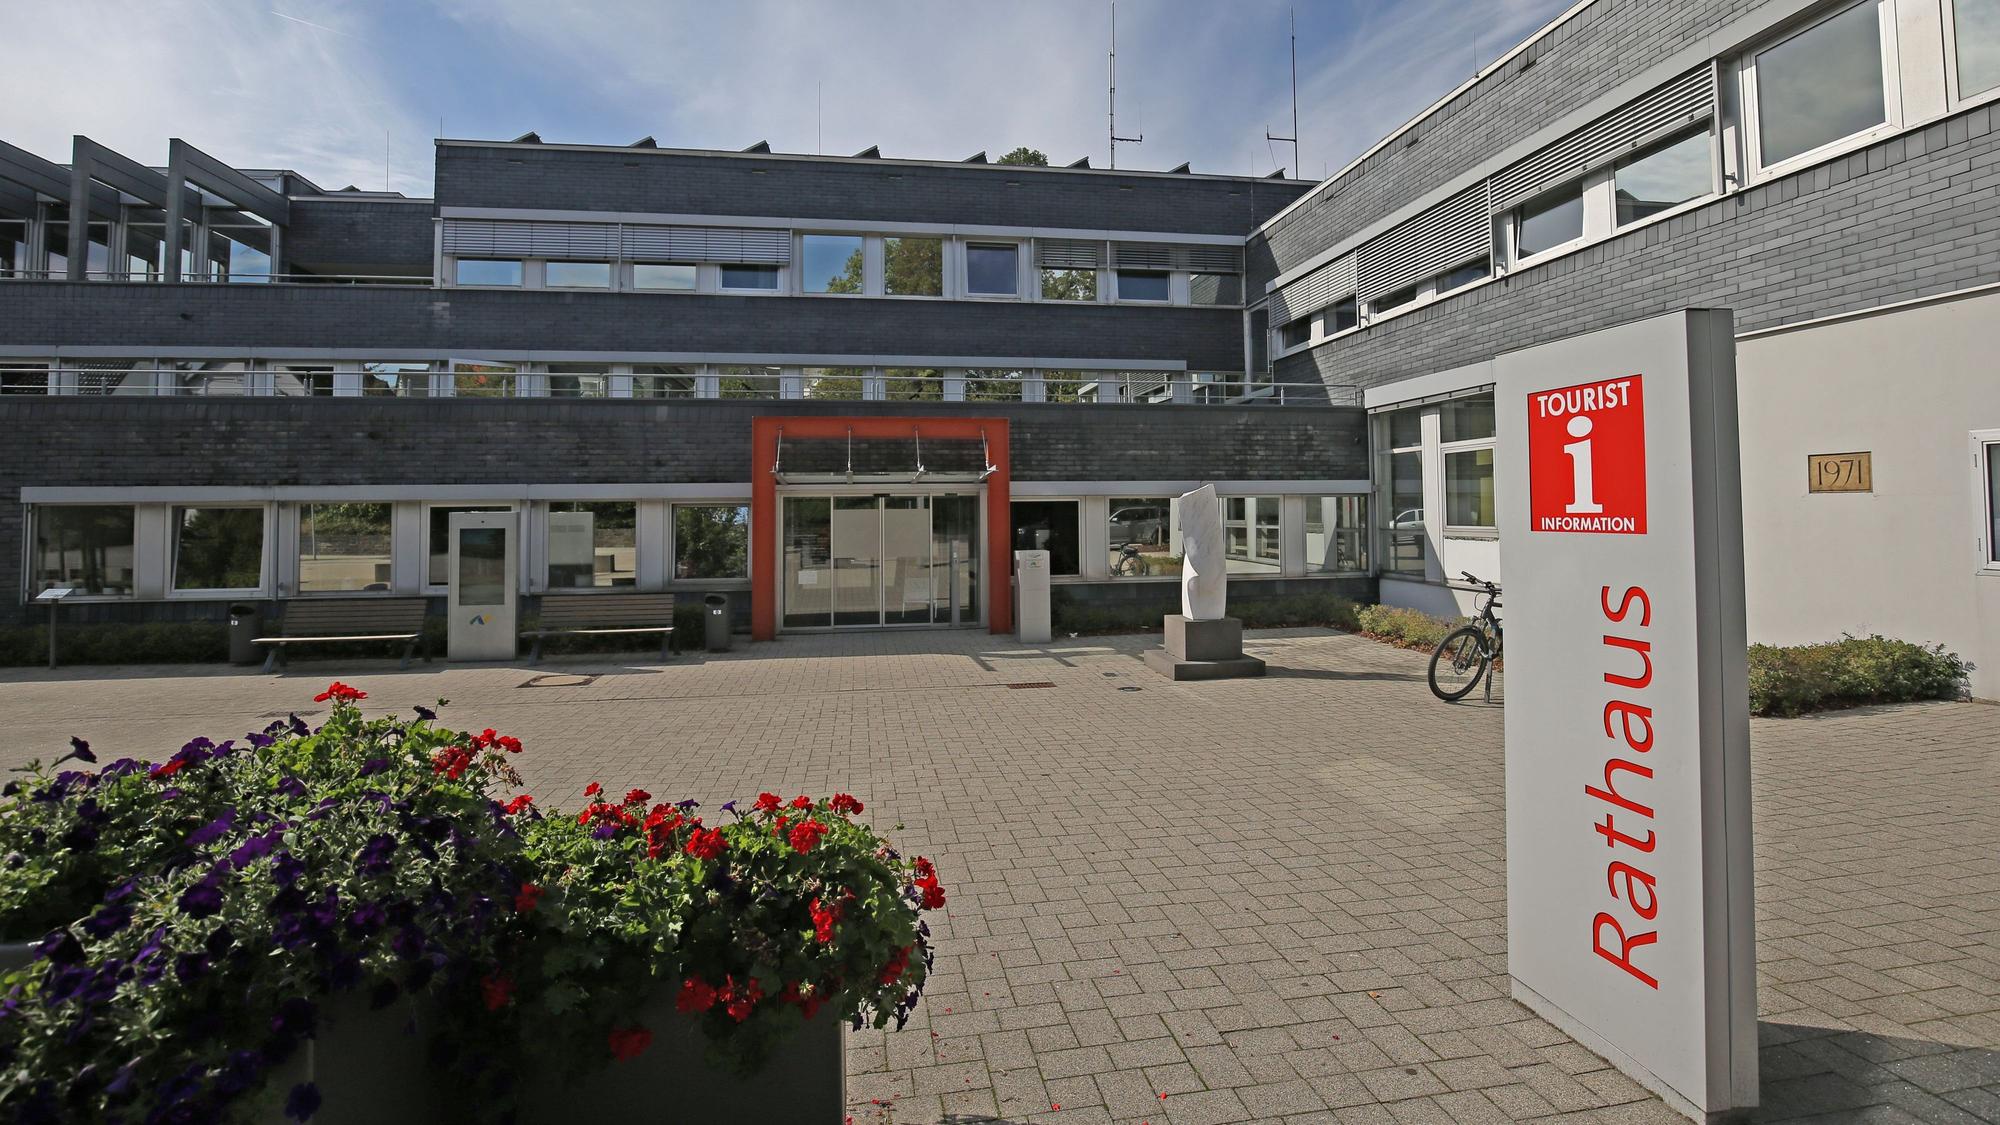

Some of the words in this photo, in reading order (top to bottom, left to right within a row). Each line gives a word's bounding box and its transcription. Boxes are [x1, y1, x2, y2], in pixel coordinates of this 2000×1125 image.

[1537, 381, 1631, 418] TOURIST
[1563, 415, 1604, 514] i
[1818, 459, 1862, 488] 1971
[1541, 516, 1635, 532] INFORMATION
[1585, 585, 1659, 990] Rathaus
